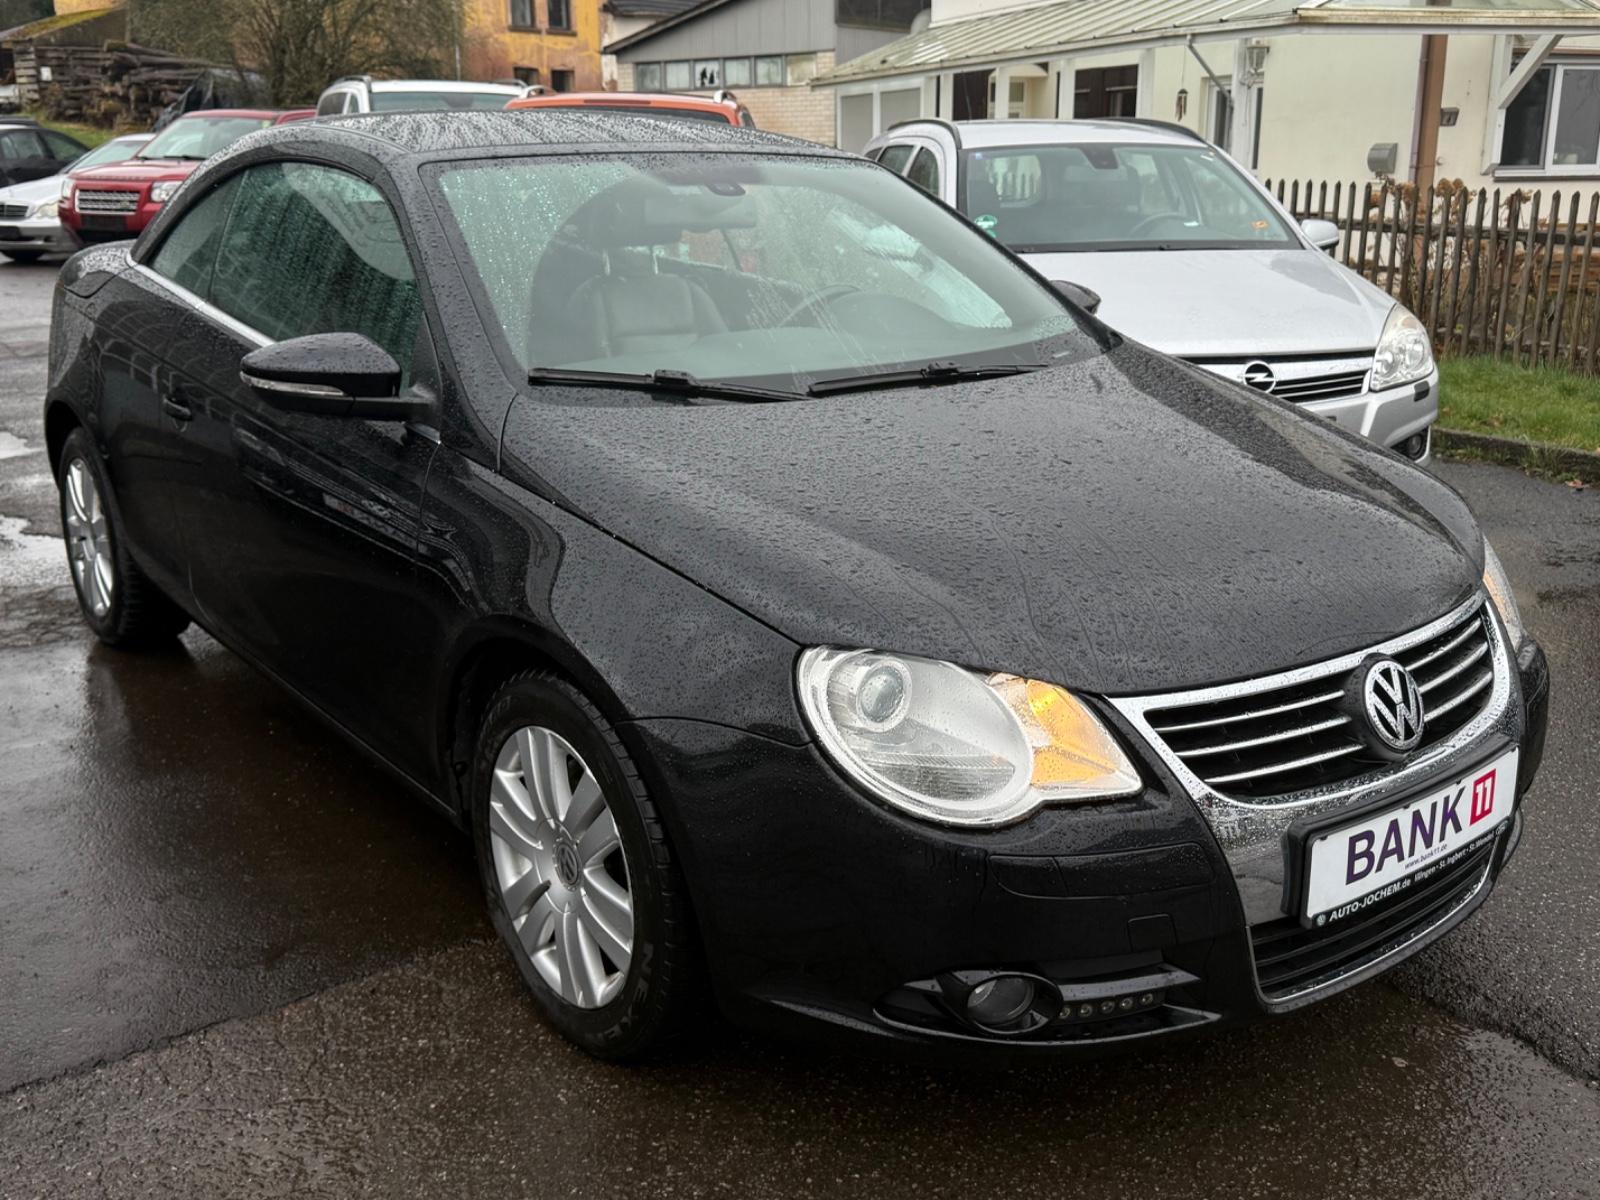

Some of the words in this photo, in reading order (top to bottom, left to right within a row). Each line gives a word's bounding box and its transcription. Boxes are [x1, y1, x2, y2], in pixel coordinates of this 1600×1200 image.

[1364, 659, 1423, 750] VW
[1345, 787, 1466, 886] BANK
[1470, 770, 1496, 825] 11
[1329, 878, 1411, 921] AUTO-JOCHEM.de
